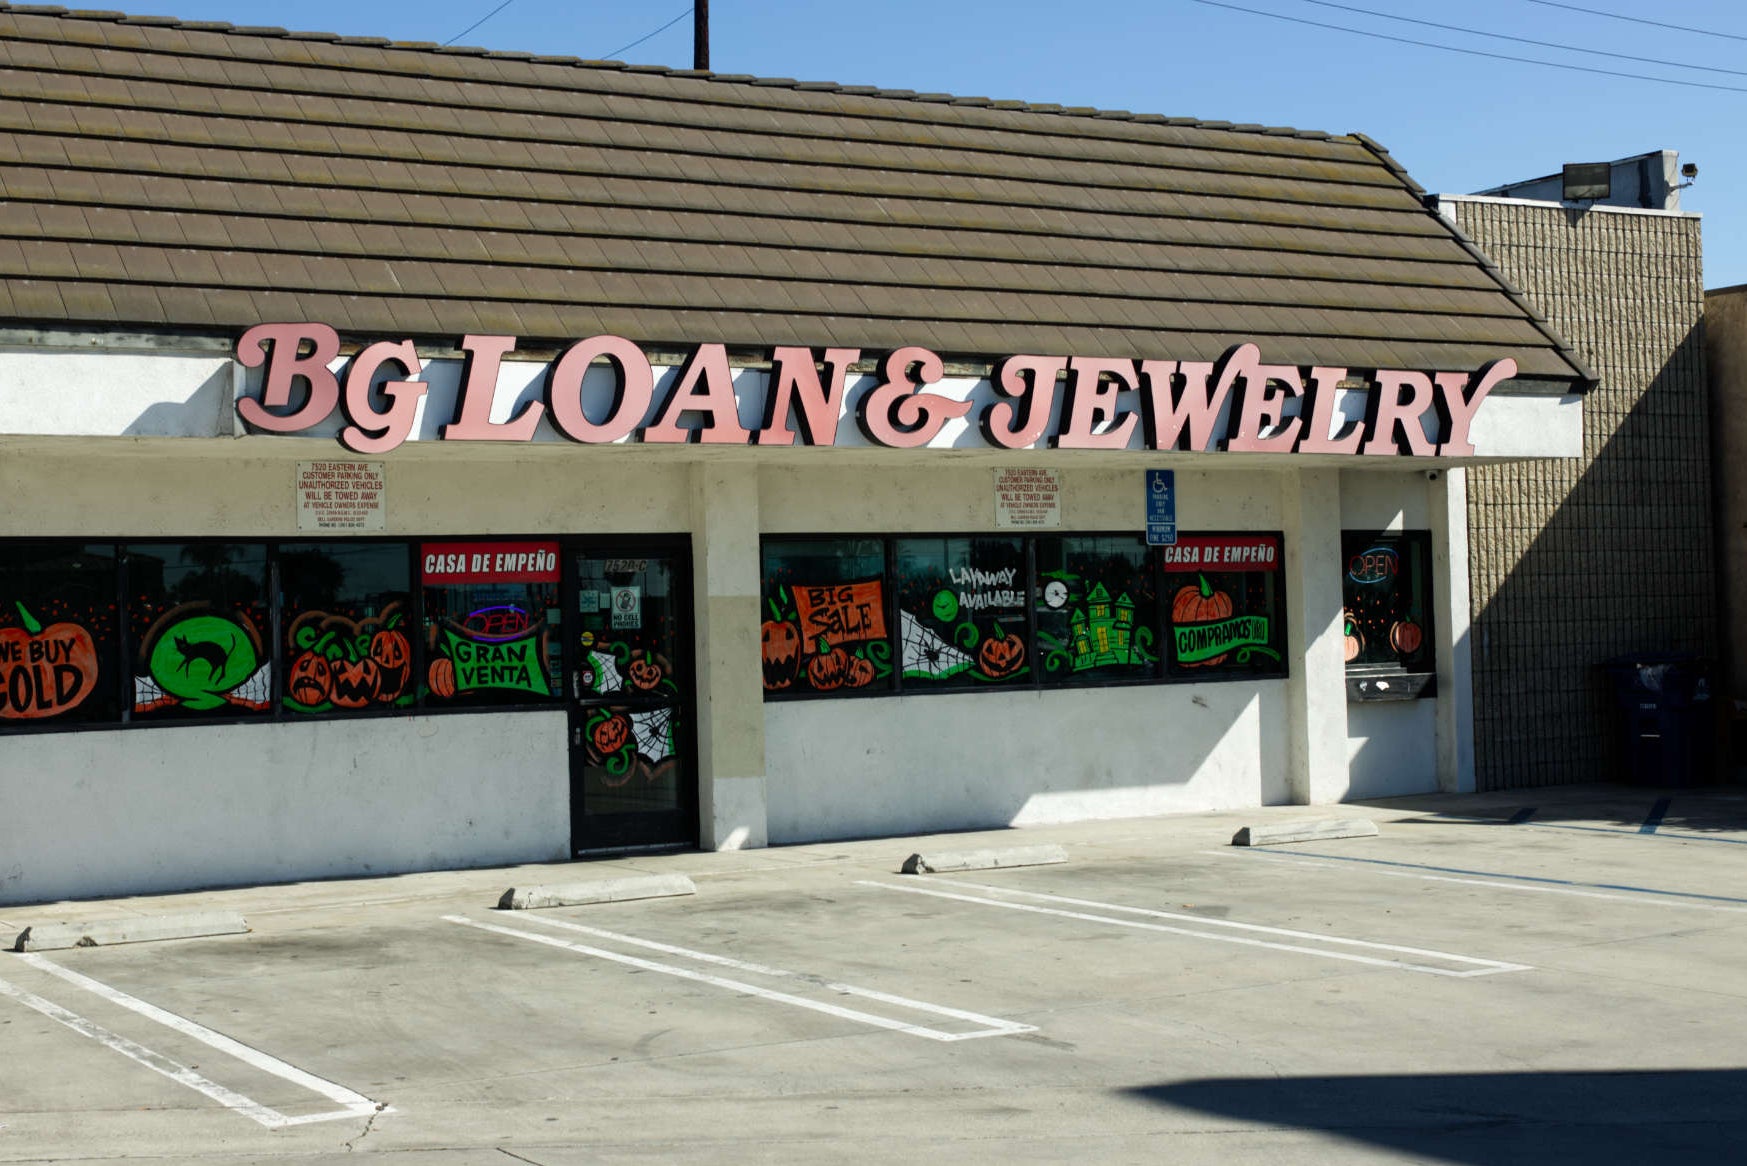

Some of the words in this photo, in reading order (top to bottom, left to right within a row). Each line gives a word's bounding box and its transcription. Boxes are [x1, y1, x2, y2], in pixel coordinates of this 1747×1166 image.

[440, 334, 861, 447] LOAN
[862, 345, 974, 449] &
[986, 342, 1518, 457] JEWELRY
[302, 471, 335, 480] CUSTOMER
[337, 472, 362, 480] PARKING
[364, 472, 378, 480] ONLY
[328, 463, 355, 471] EASTERN
[298, 480, 349, 490] UNAUTHORIZED
[351, 481, 383, 490] VEHICLES
[996, 484, 1033, 492] UNAUTHORIZED
[304, 501, 310, 509] AT
[357, 502, 379, 510] EXPENSE
[305, 491, 321, 500] WILL
[323, 491, 332, 500] BE
[335, 492, 358, 501] TOWED
[361, 492, 378, 501] AWAY
[1001, 493, 1013, 501] WILL
[1014, 493, 1022, 501] BE
[1023, 493, 1041, 501] TOWED
[425, 553, 466, 574] CASA
[471, 552, 490, 573] DE
[495, 549, 556, 573] EMPEÑO
[1164, 546, 1199, 563] CASA
[1203, 546, 1220, 563] DE
[1223, 543, 1275, 563] EMPEÑO
[1348, 554, 1399, 577] OPEN
[949, 567, 1018, 587] LAYAWAY
[807, 586, 854, 607] BIG
[958, 590, 1025, 610] AVAILABLE
[463, 612, 530, 636] OPEN
[623, 614, 639, 622] CELL
[1178, 619, 1251, 654] COMPRAMOS
[29, 637, 76, 663] BUY
[455, 641, 528, 664] GRAN
[461, 664, 533, 689] VENTA
